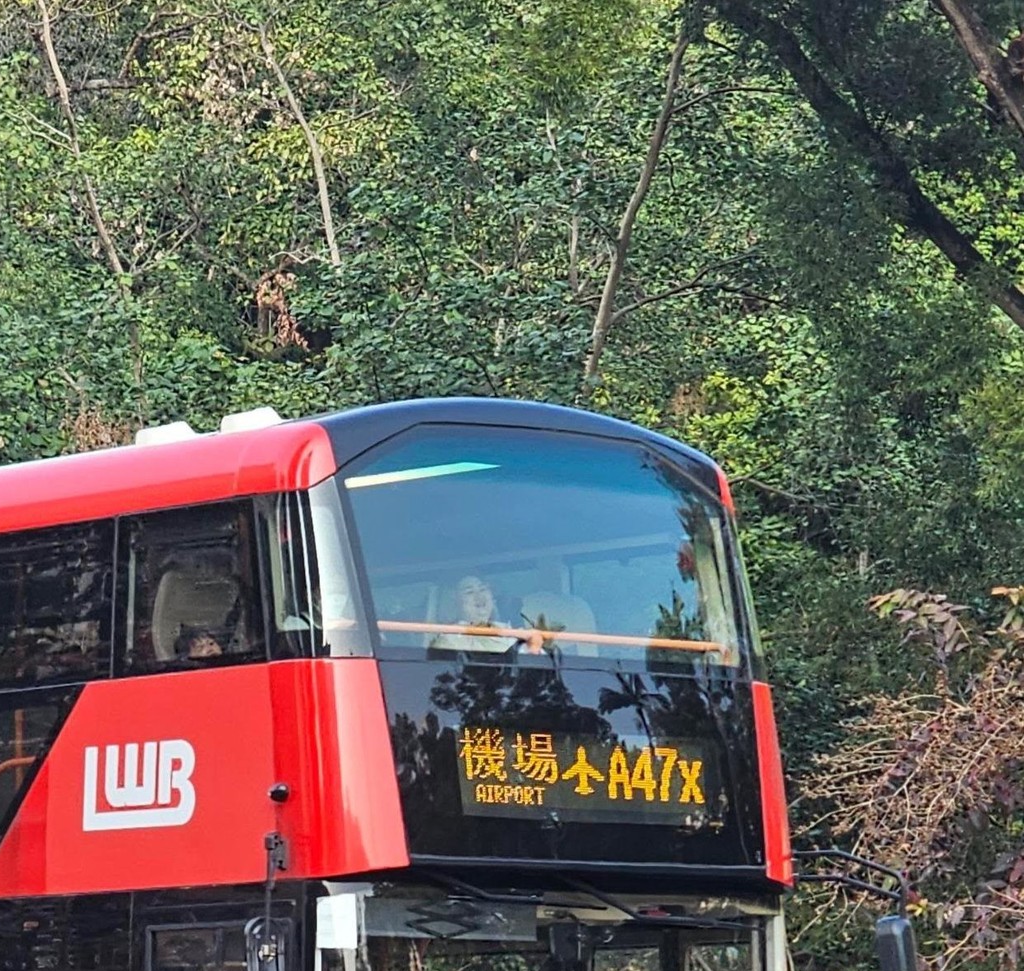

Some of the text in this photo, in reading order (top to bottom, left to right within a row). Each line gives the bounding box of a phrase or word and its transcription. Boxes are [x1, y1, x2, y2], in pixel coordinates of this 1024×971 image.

[460, 727, 559, 784] 機場
[82, 738, 196, 832] LWB
[475, 784, 546, 805] AIRPORT
